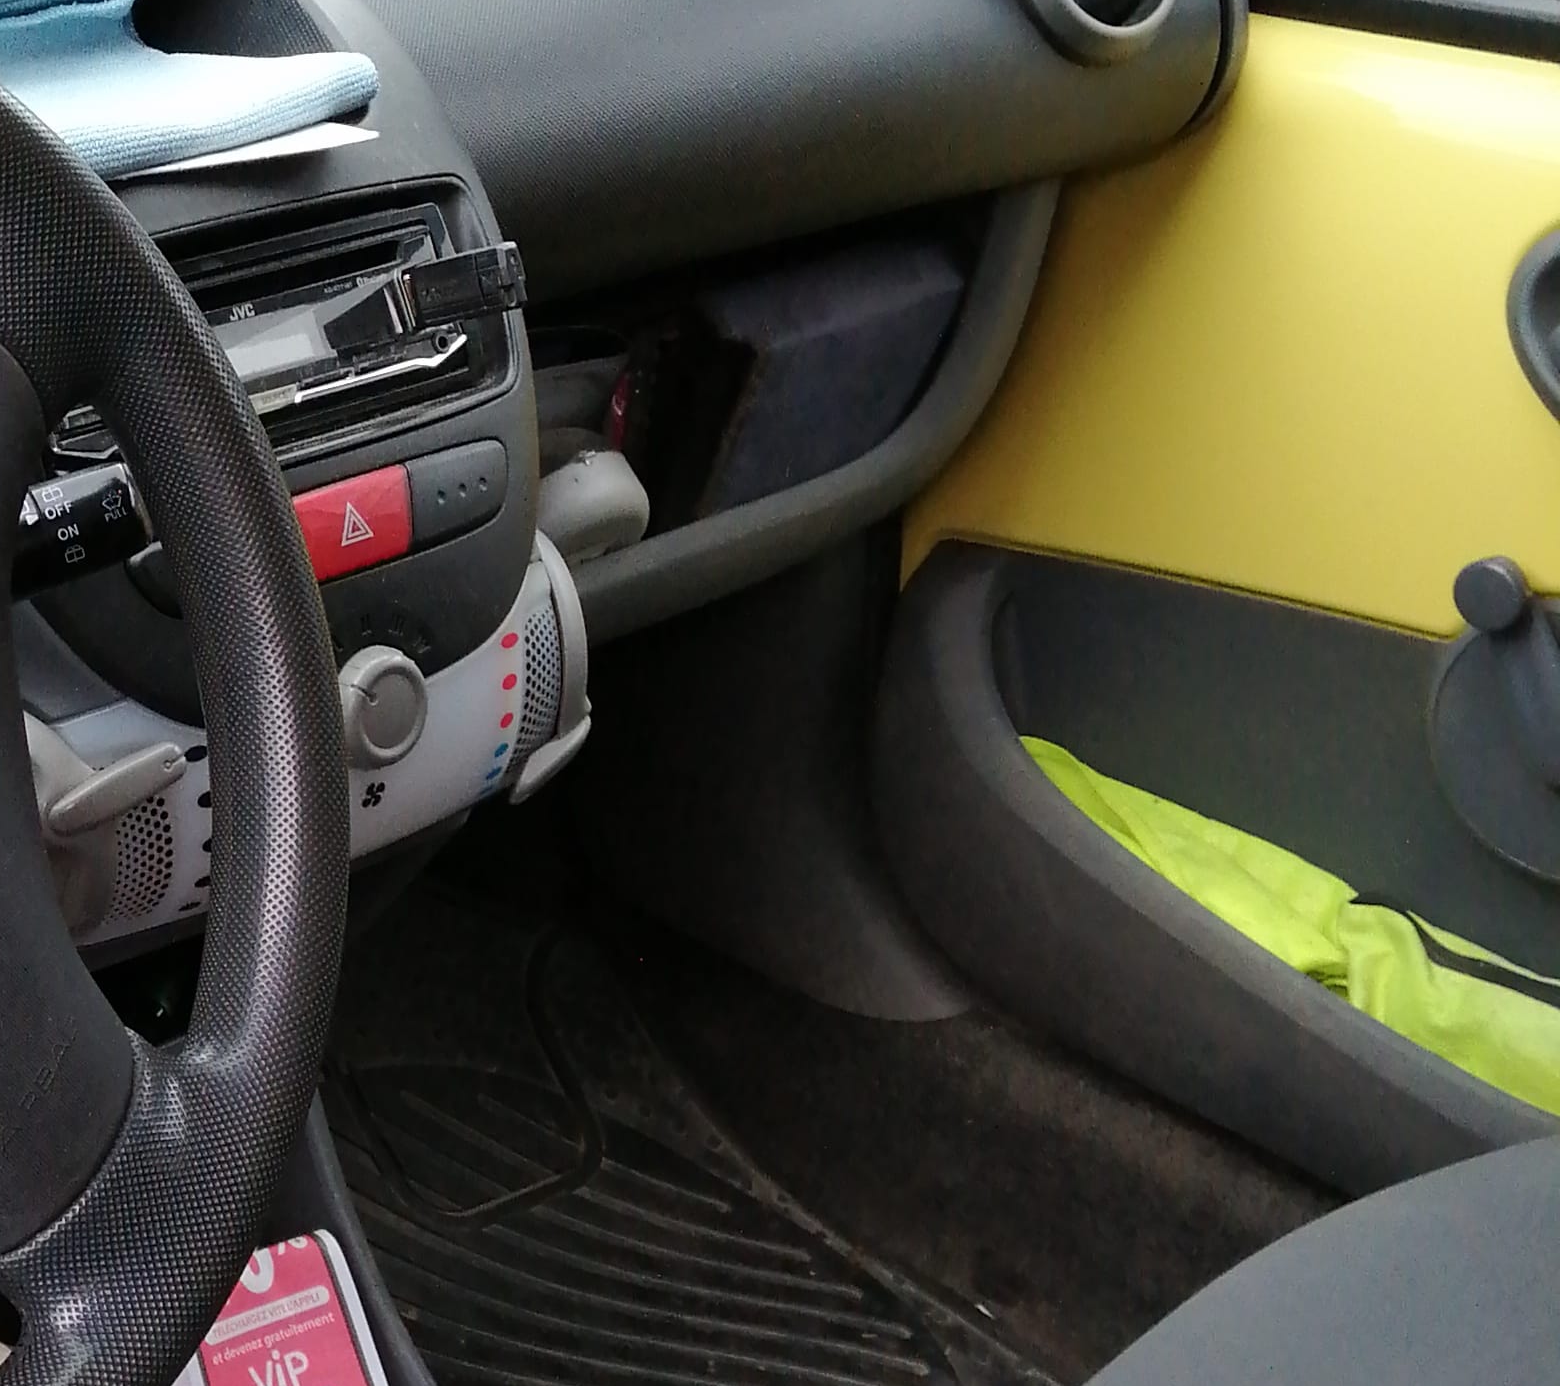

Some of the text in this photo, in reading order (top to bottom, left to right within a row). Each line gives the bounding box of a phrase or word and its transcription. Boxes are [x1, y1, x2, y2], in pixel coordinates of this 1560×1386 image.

[229, 303, 256, 321] JVC
[44, 500, 73, 520] OFF
[57, 523, 80, 541] ON
[212, 1312, 336, 1365] et devenez gratuitement
